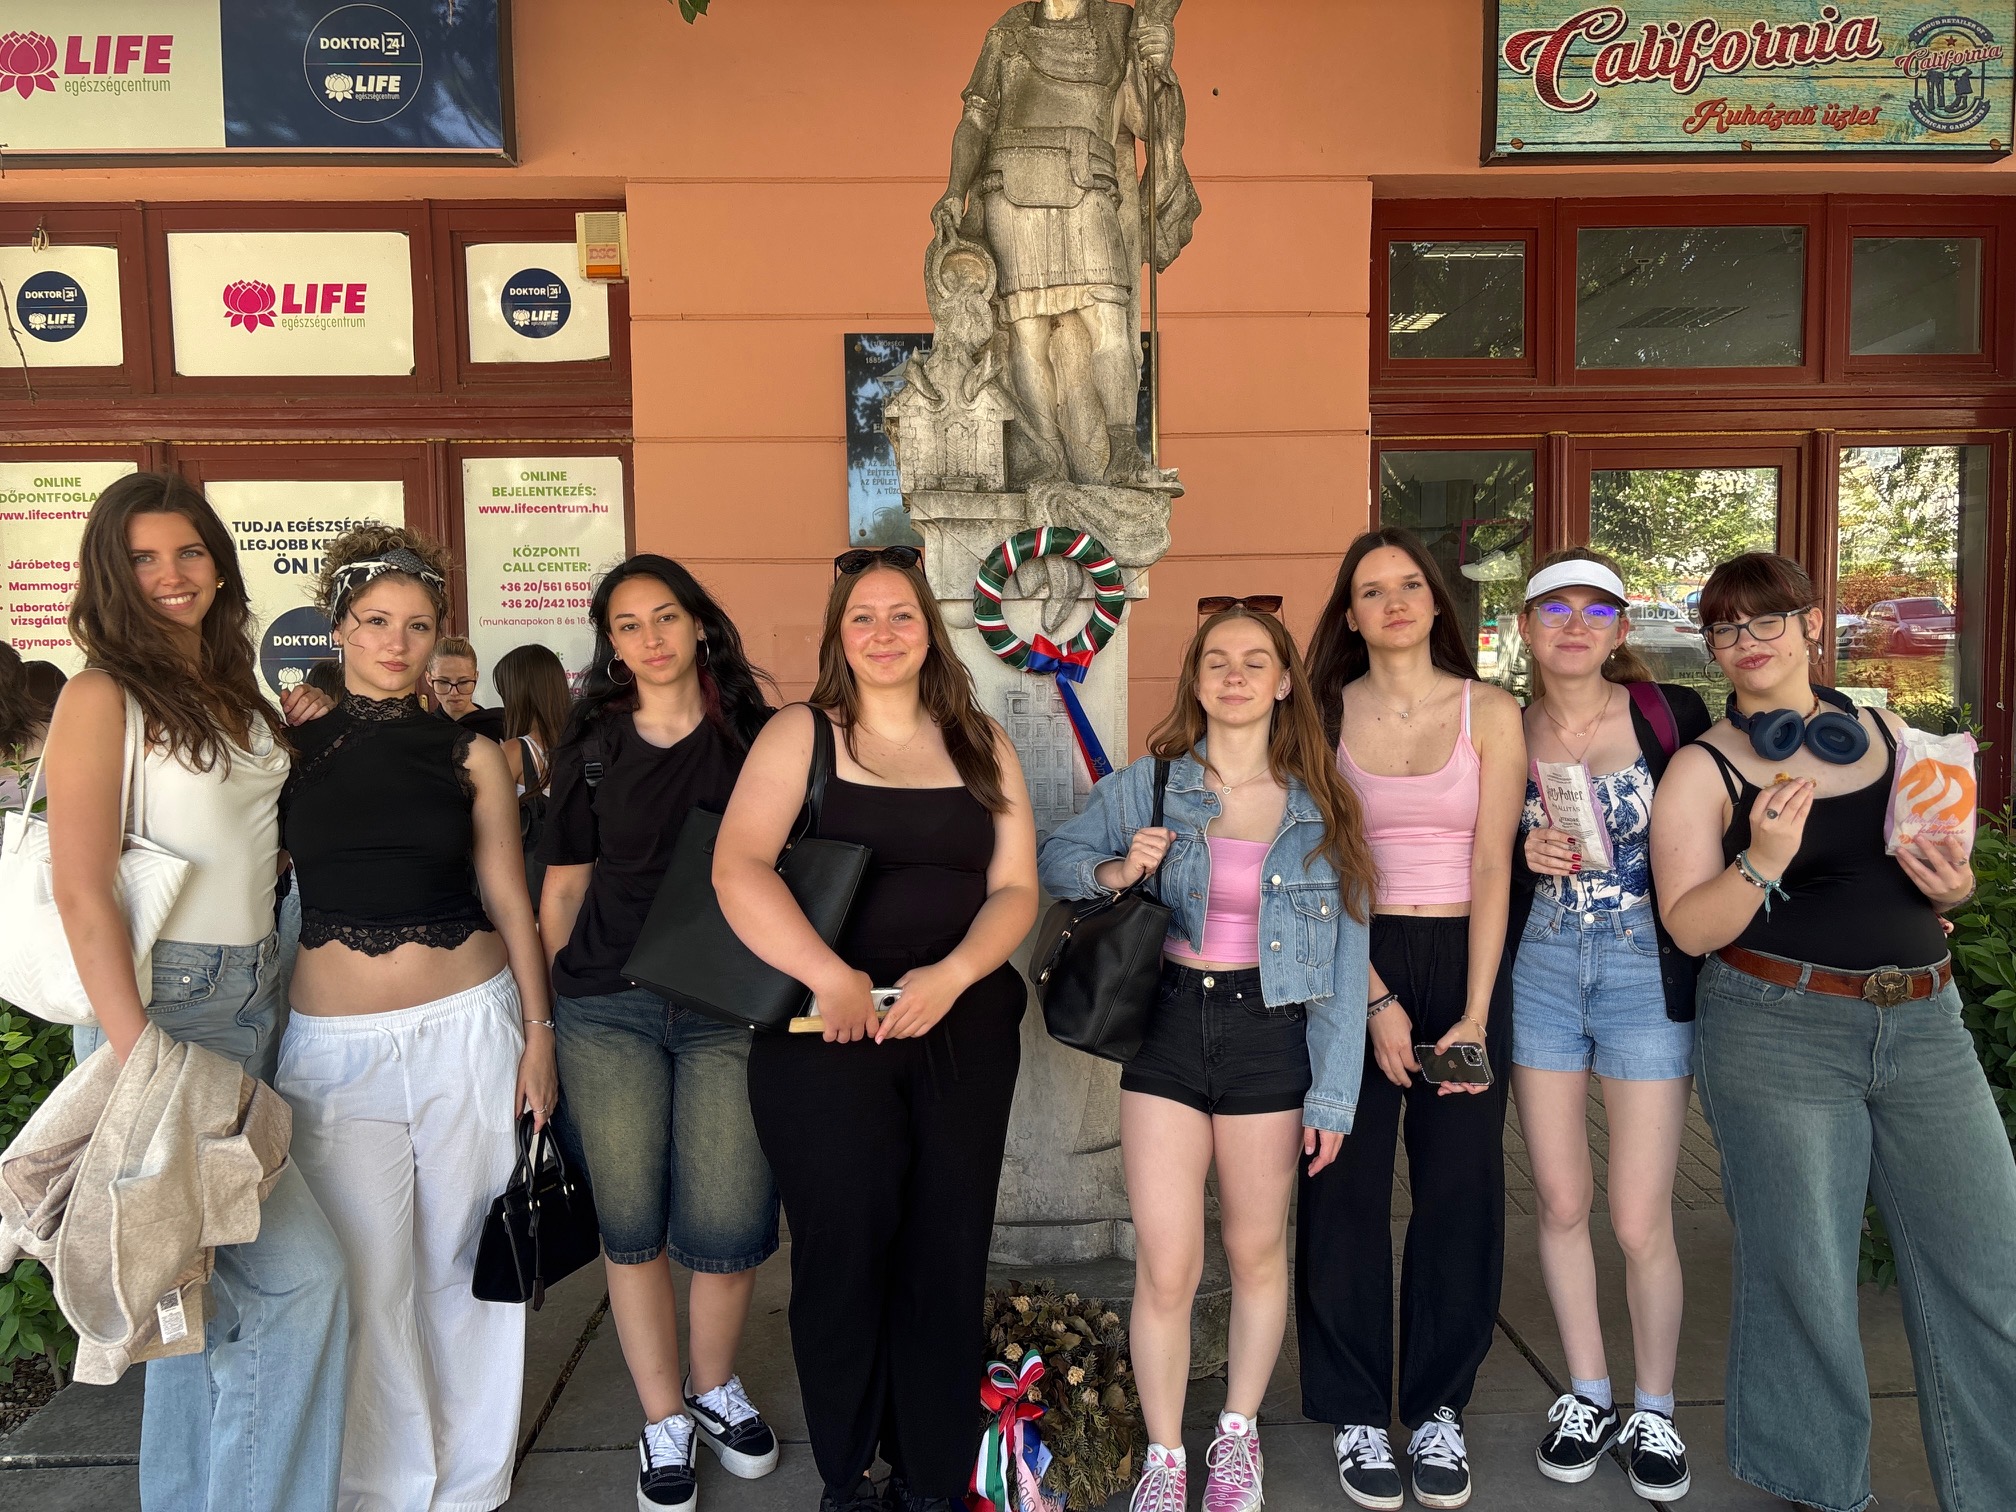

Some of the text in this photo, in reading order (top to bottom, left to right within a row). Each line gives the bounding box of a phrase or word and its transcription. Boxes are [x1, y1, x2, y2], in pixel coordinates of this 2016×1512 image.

[1917, 19, 1941, 34] PROUD
[320, 37, 380, 50] DOKTOR
[64, 34, 174, 75] LIFE
[1502, 5, 1885, 112] California
[1894, 44, 2003, 79] California
[64, 76, 171, 97] egészségcentrum
[355, 75, 401, 93] LIFE
[1682, 97, 1883, 135] Ruházati üzlet
[1913, 108, 1947, 130] AMERICAN
[589, 248, 616, 259] DSC
[25, 291, 62, 299] DOKTOR
[509, 287, 547, 296] DOKTOR
[281, 283, 367, 314] LIFE
[47, 313, 76, 325] LIFE
[531, 310, 559, 321] LIFE
[281, 315, 366, 331] egészségcentrum
[33, 477, 82, 488] ONLINE
[520, 471, 567, 482] ONLINE
[0, 489, 99, 503] DŐPONTFOGLA
[492, 483, 597, 497] BEJELENTKEZÉS:
[478, 502, 609, 514] www.lifecentrum.hu
[232, 520, 282, 533] TUDJA
[240, 538, 308, 551] LEGJOBB
[512, 544, 580, 557] KÖZPONTI
[8, 559, 71, 572] Járóbeteg
[273, 553, 308, 575] ÖN
[502, 561, 591, 573] CALL CENTER:
[500, 580, 591, 594] +36 20/561 6501
[501, 599, 522, 608] +36
[524, 596, 565, 610] 20/242
[11, 615, 68, 628] vizsgálat
[479, 616, 586, 628] (munkanapokon 8 és 16
[12, 638, 72, 650] Egynapos
[273, 635, 327, 647] DOKTOR
